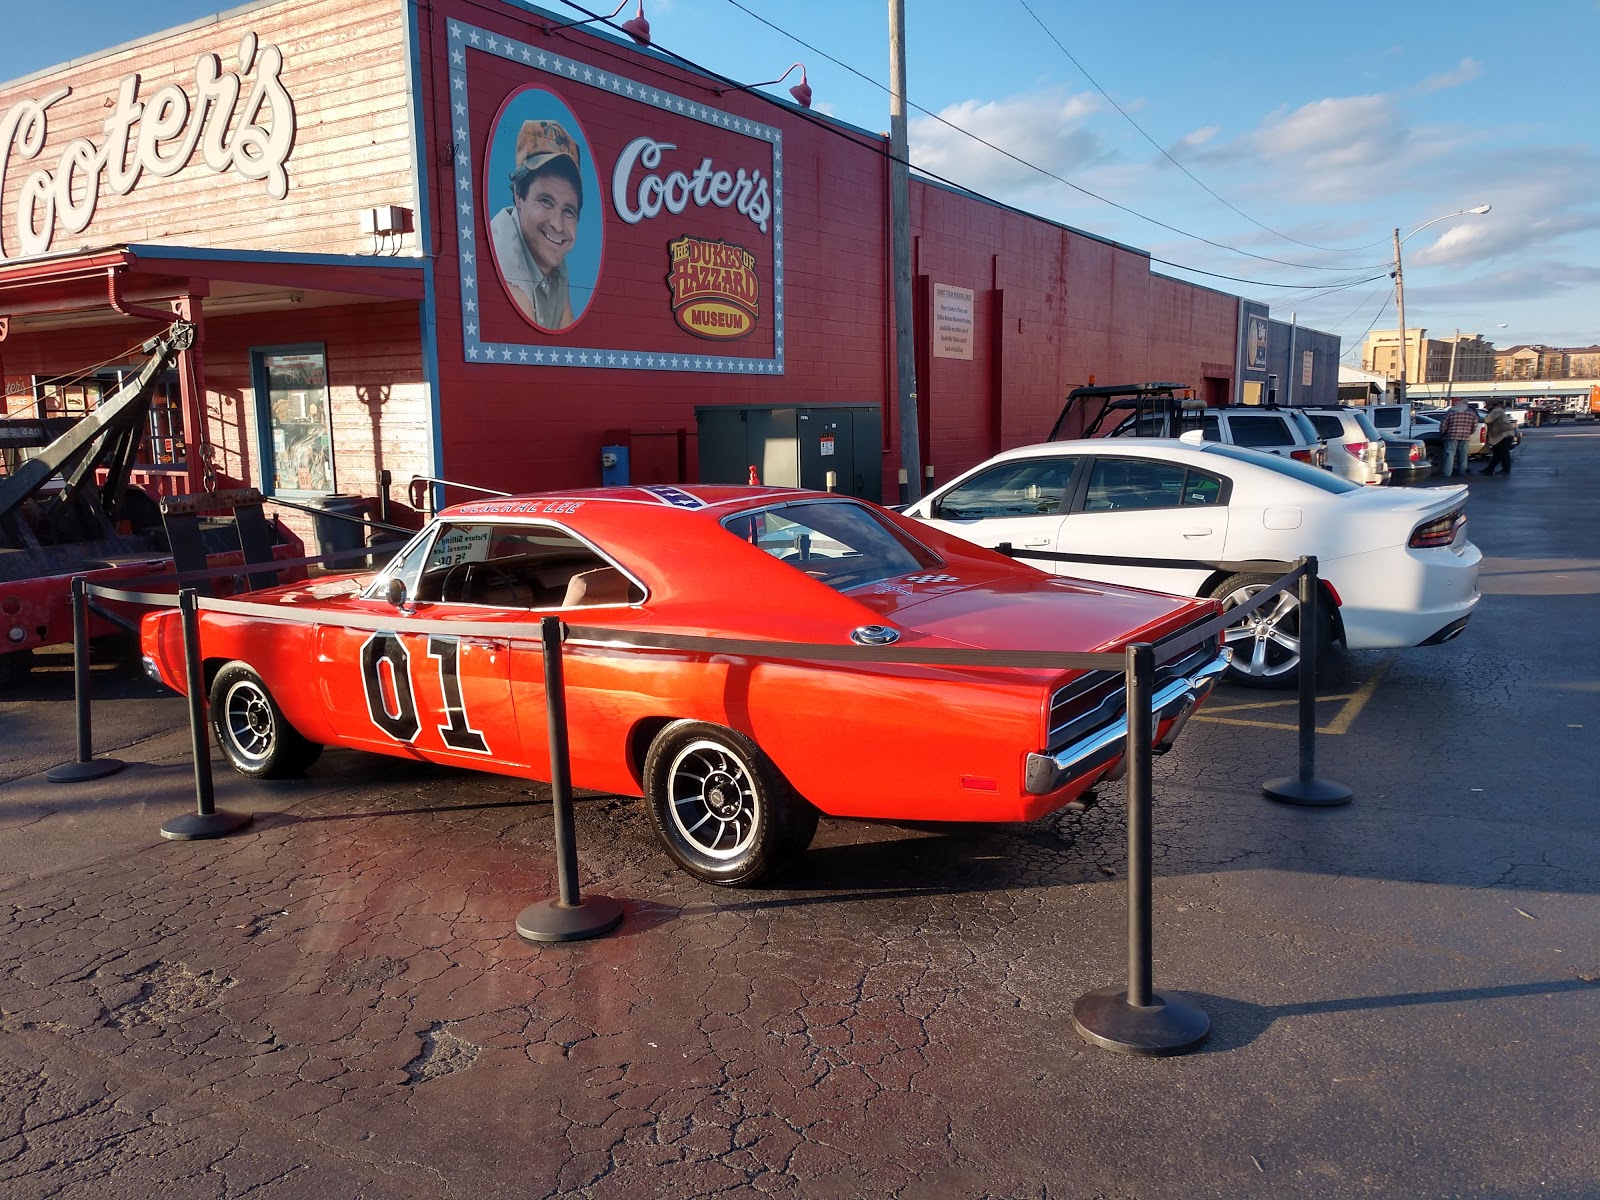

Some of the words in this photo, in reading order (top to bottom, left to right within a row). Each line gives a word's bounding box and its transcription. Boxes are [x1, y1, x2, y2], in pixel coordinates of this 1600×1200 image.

[0, 31, 297, 257] Cooter's
[612, 136, 771, 234] Cooter's
[671, 238, 690, 261] THE
[689, 239, 743, 270] DUKES
[743, 251, 755, 270] OF
[669, 258, 758, 306] HAZZARD
[691, 309, 743, 329] MUSEUM
[21, 427, 41, 437] 440
[459, 501, 543, 514] GENERAL
[542, 501, 586, 514] LEE
[360, 630, 493, 756] 01
